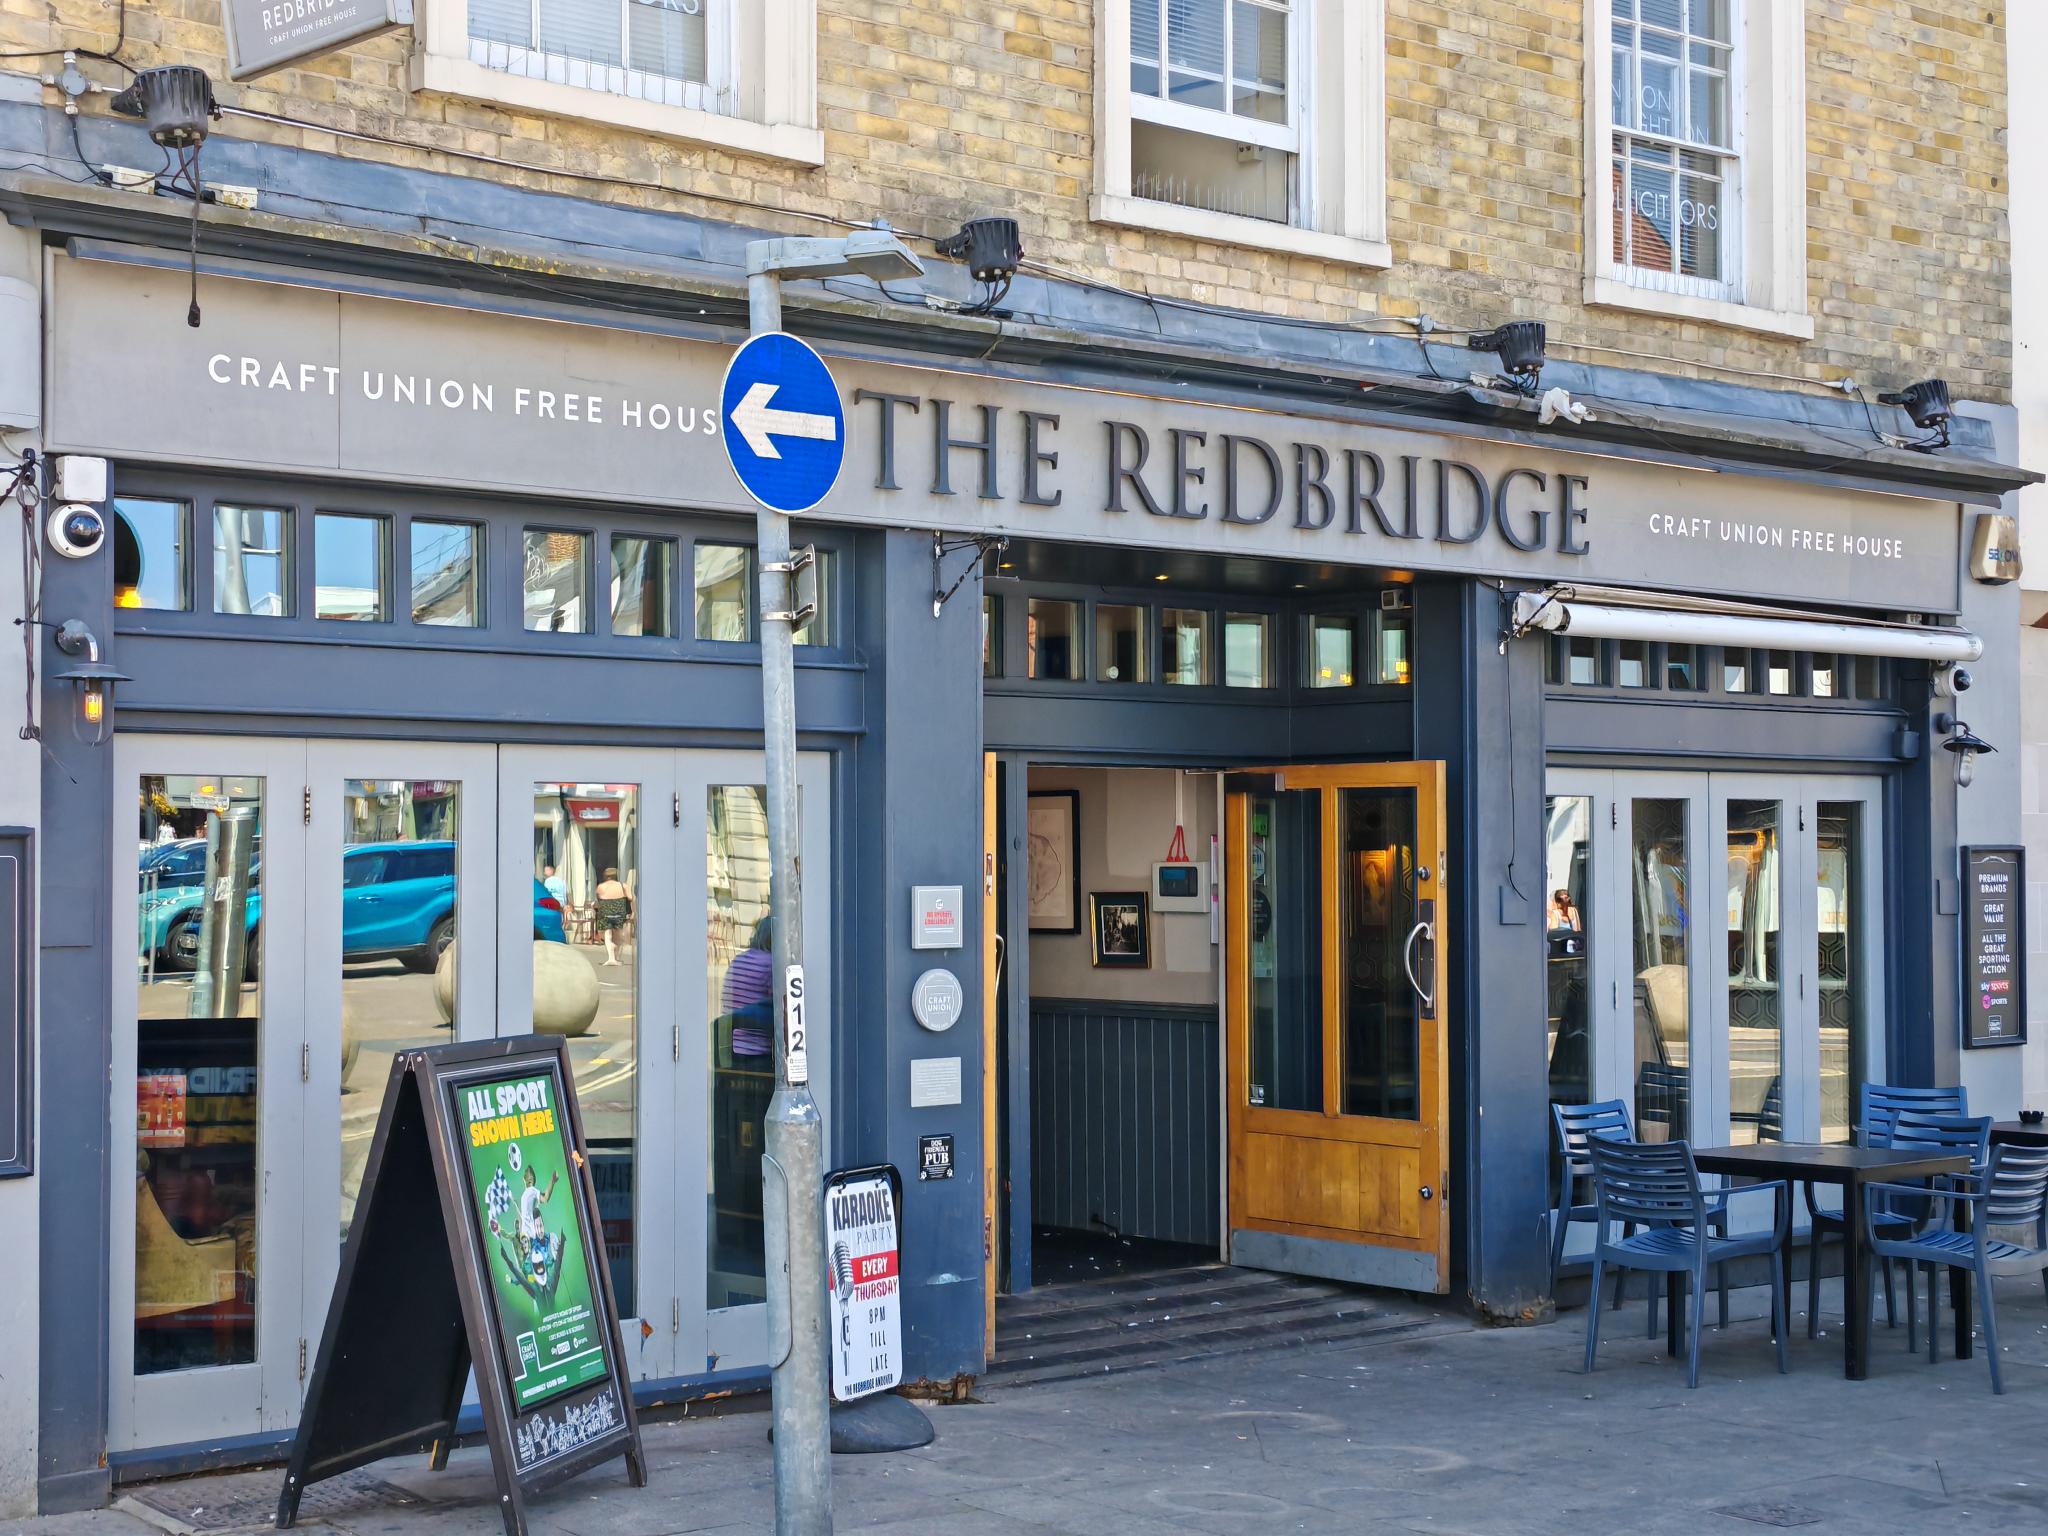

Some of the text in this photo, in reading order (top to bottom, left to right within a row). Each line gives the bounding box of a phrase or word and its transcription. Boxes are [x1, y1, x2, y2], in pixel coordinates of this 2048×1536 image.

[269, 6, 356, 46] CRAFT UNION FREE HOUSE
[1614, 186, 1718, 231] LICITORS
[208, 354, 717, 435] CRAFT UNION FREE HOUS
[853, 387, 1591, 556] THE REDBRIDGE
[1649, 513, 1902, 560] CRAFT UNION FREE HOUSE
[1978, 873, 2009, 884] PREMIUM
[1980, 884, 2007, 894] BRANDS
[1983, 903, 2005, 913] GREAT
[1983, 914, 2005, 923] VALUE
[1981, 933, 2007, 943] ALL THE
[1984, 944, 2005, 954] GREAT
[1978, 954, 2011, 964] SPORTING
[1982, 965, 2007, 975] ACTION
[1980, 981, 2009, 992] sky sports
[927, 1004, 952, 1012] UNION
[928, 996, 952, 1005] CRAFT
[467, 1080, 548, 1121] ALL SPORT
[469, 1108, 555, 1147] SHOWN HERE
[925, 1152, 950, 1166] PUB
[831, 1188, 892, 1232] KARAOKE
[856, 1224, 893, 1245] PARTY
[861, 1257, 888, 1278] EVERY
[854, 1278, 898, 1303] THURSDAY
[870, 1330, 886, 1348] TILL
[870, 1352, 888, 1373] LATE
